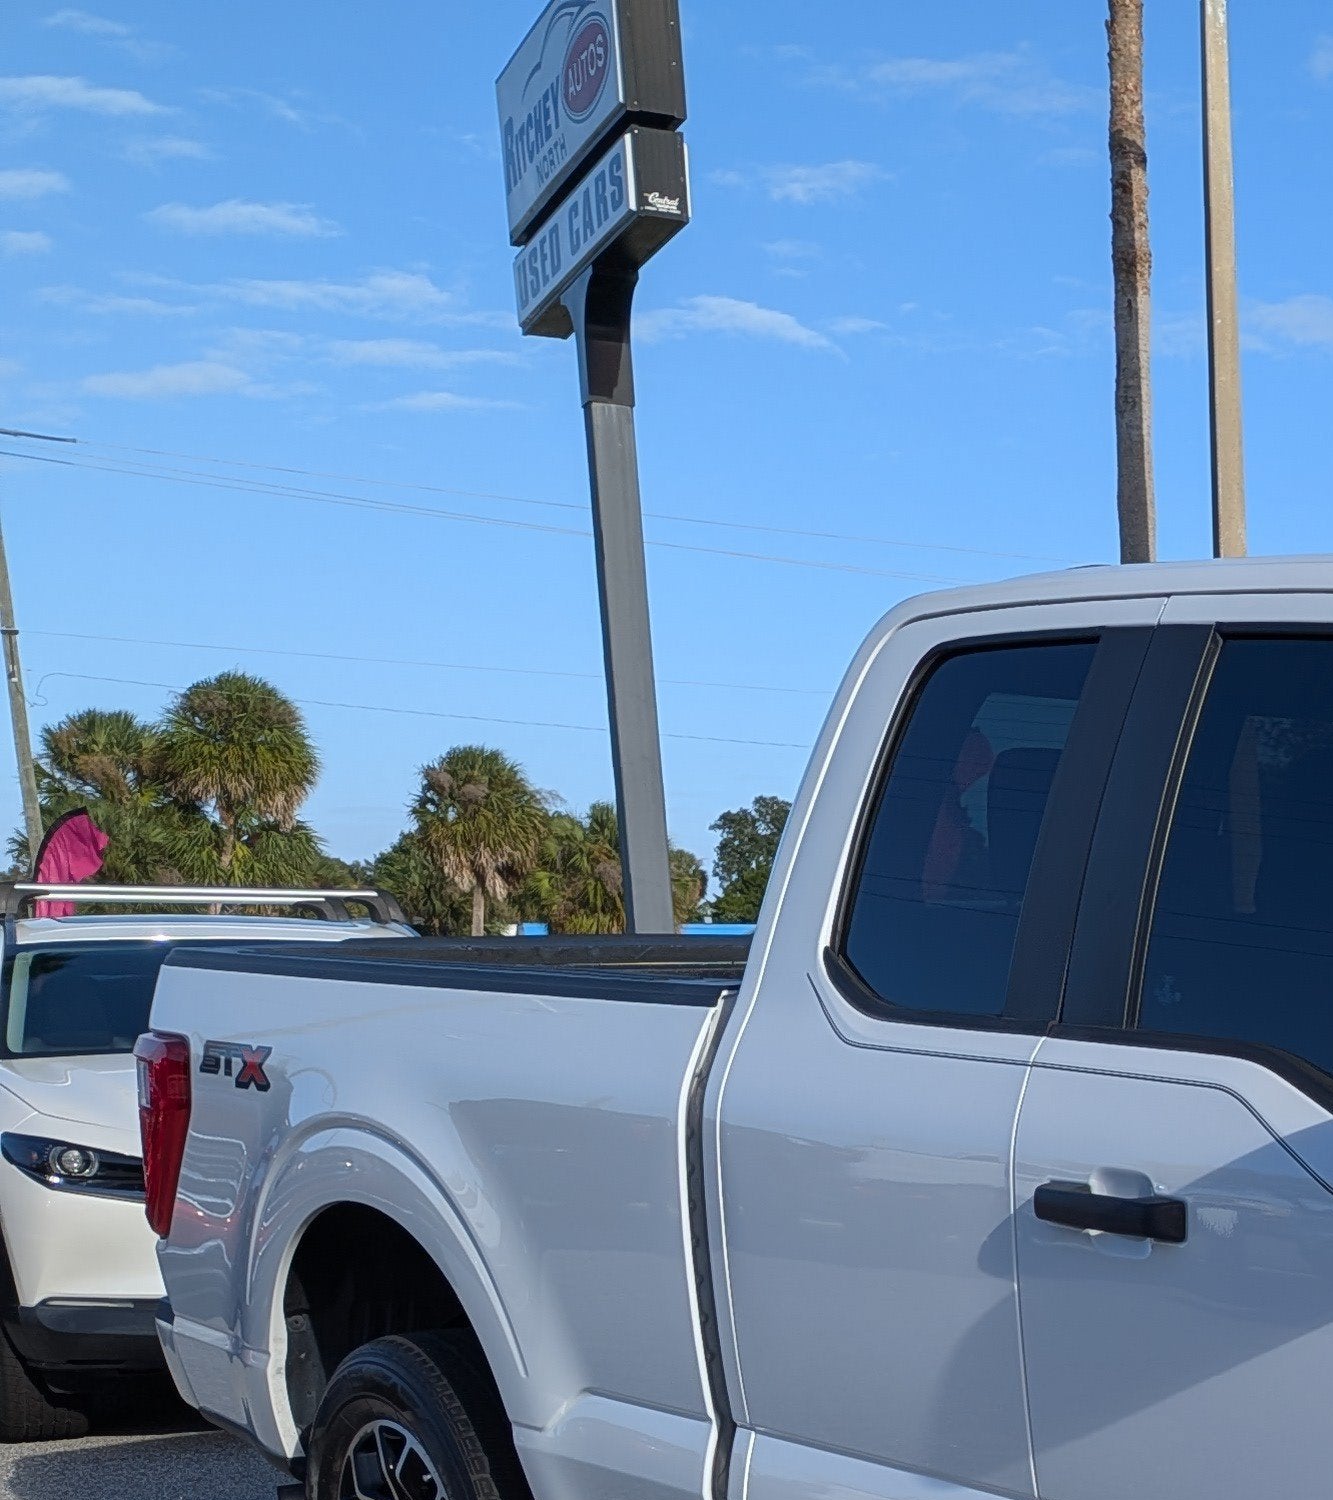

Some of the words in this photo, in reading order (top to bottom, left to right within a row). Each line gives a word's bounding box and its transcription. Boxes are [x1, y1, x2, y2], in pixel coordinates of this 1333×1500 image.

[569, 34, 605, 101] AUTOS
[503, 75, 560, 197] RITCHEY
[535, 134, 567, 188] NORTH
[517, 223, 561, 310] USED
[569, 153, 624, 256] CARS
[199, 1039, 274, 1092] STX
